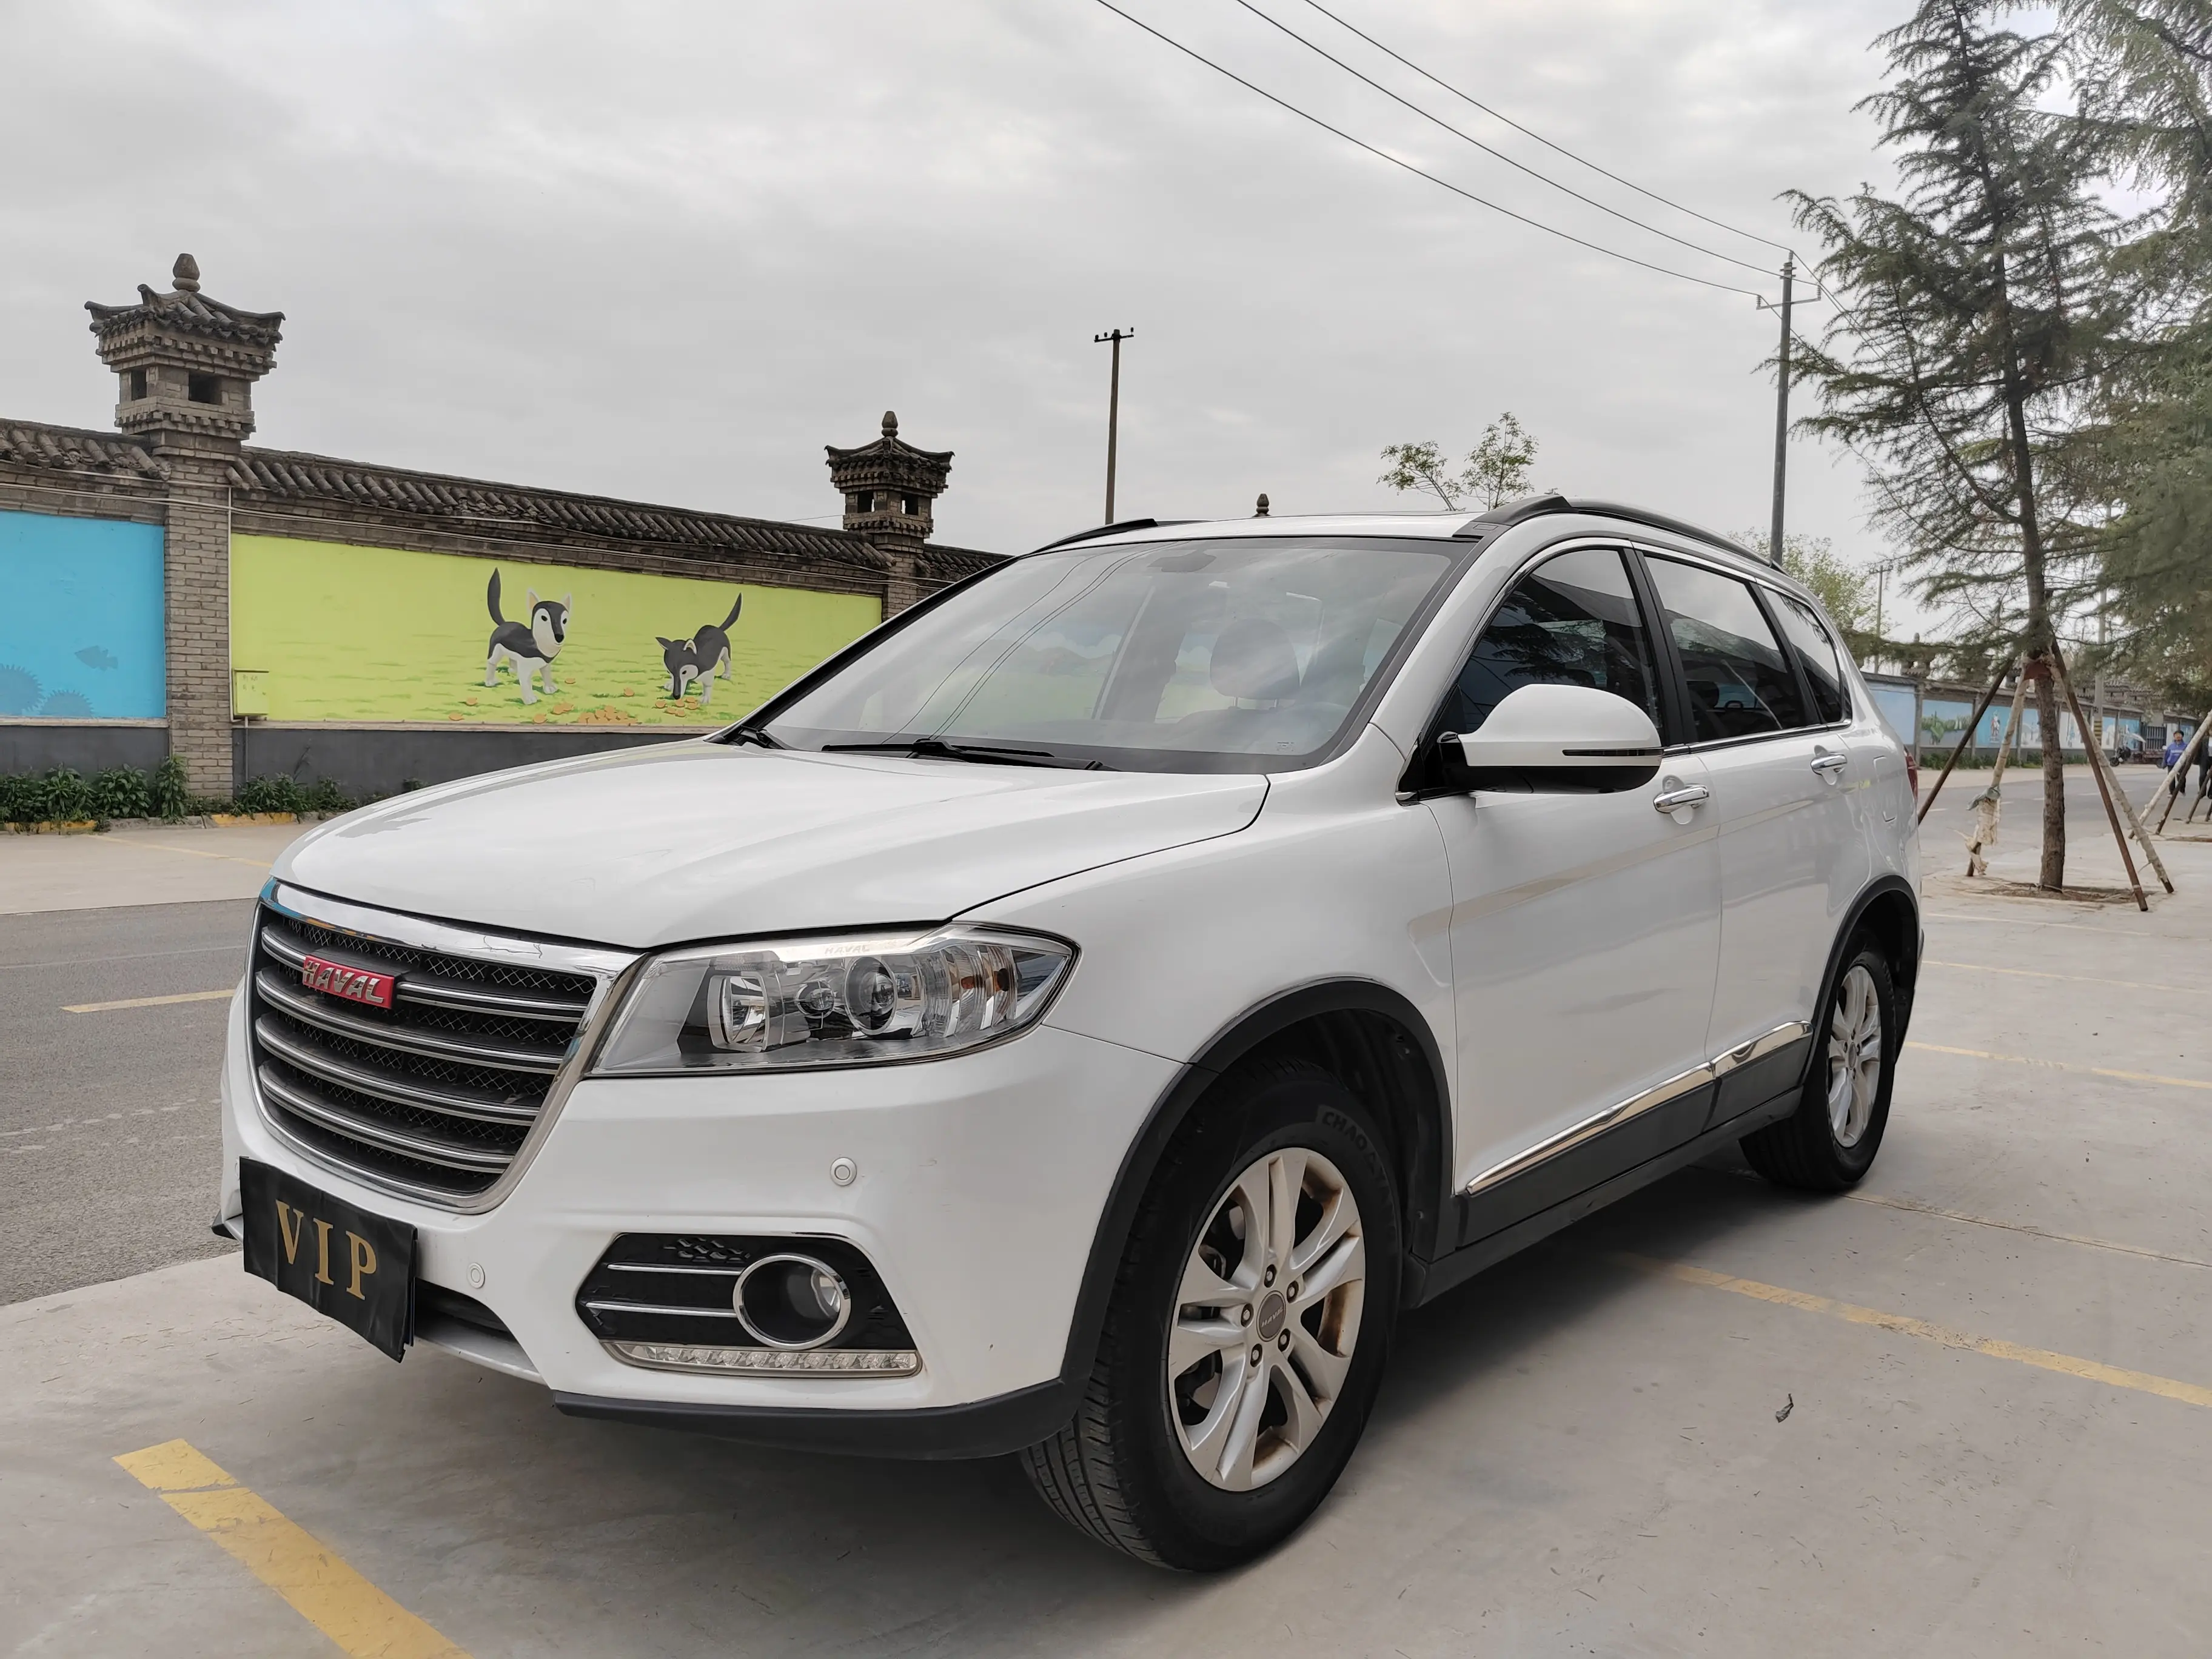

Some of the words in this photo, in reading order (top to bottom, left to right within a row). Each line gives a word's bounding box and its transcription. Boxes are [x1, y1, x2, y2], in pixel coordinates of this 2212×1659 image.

[824, 944, 870, 954] HAVAL
[303, 960, 384, 1004] HAVAL
[276, 1199, 377, 1301] VIP
